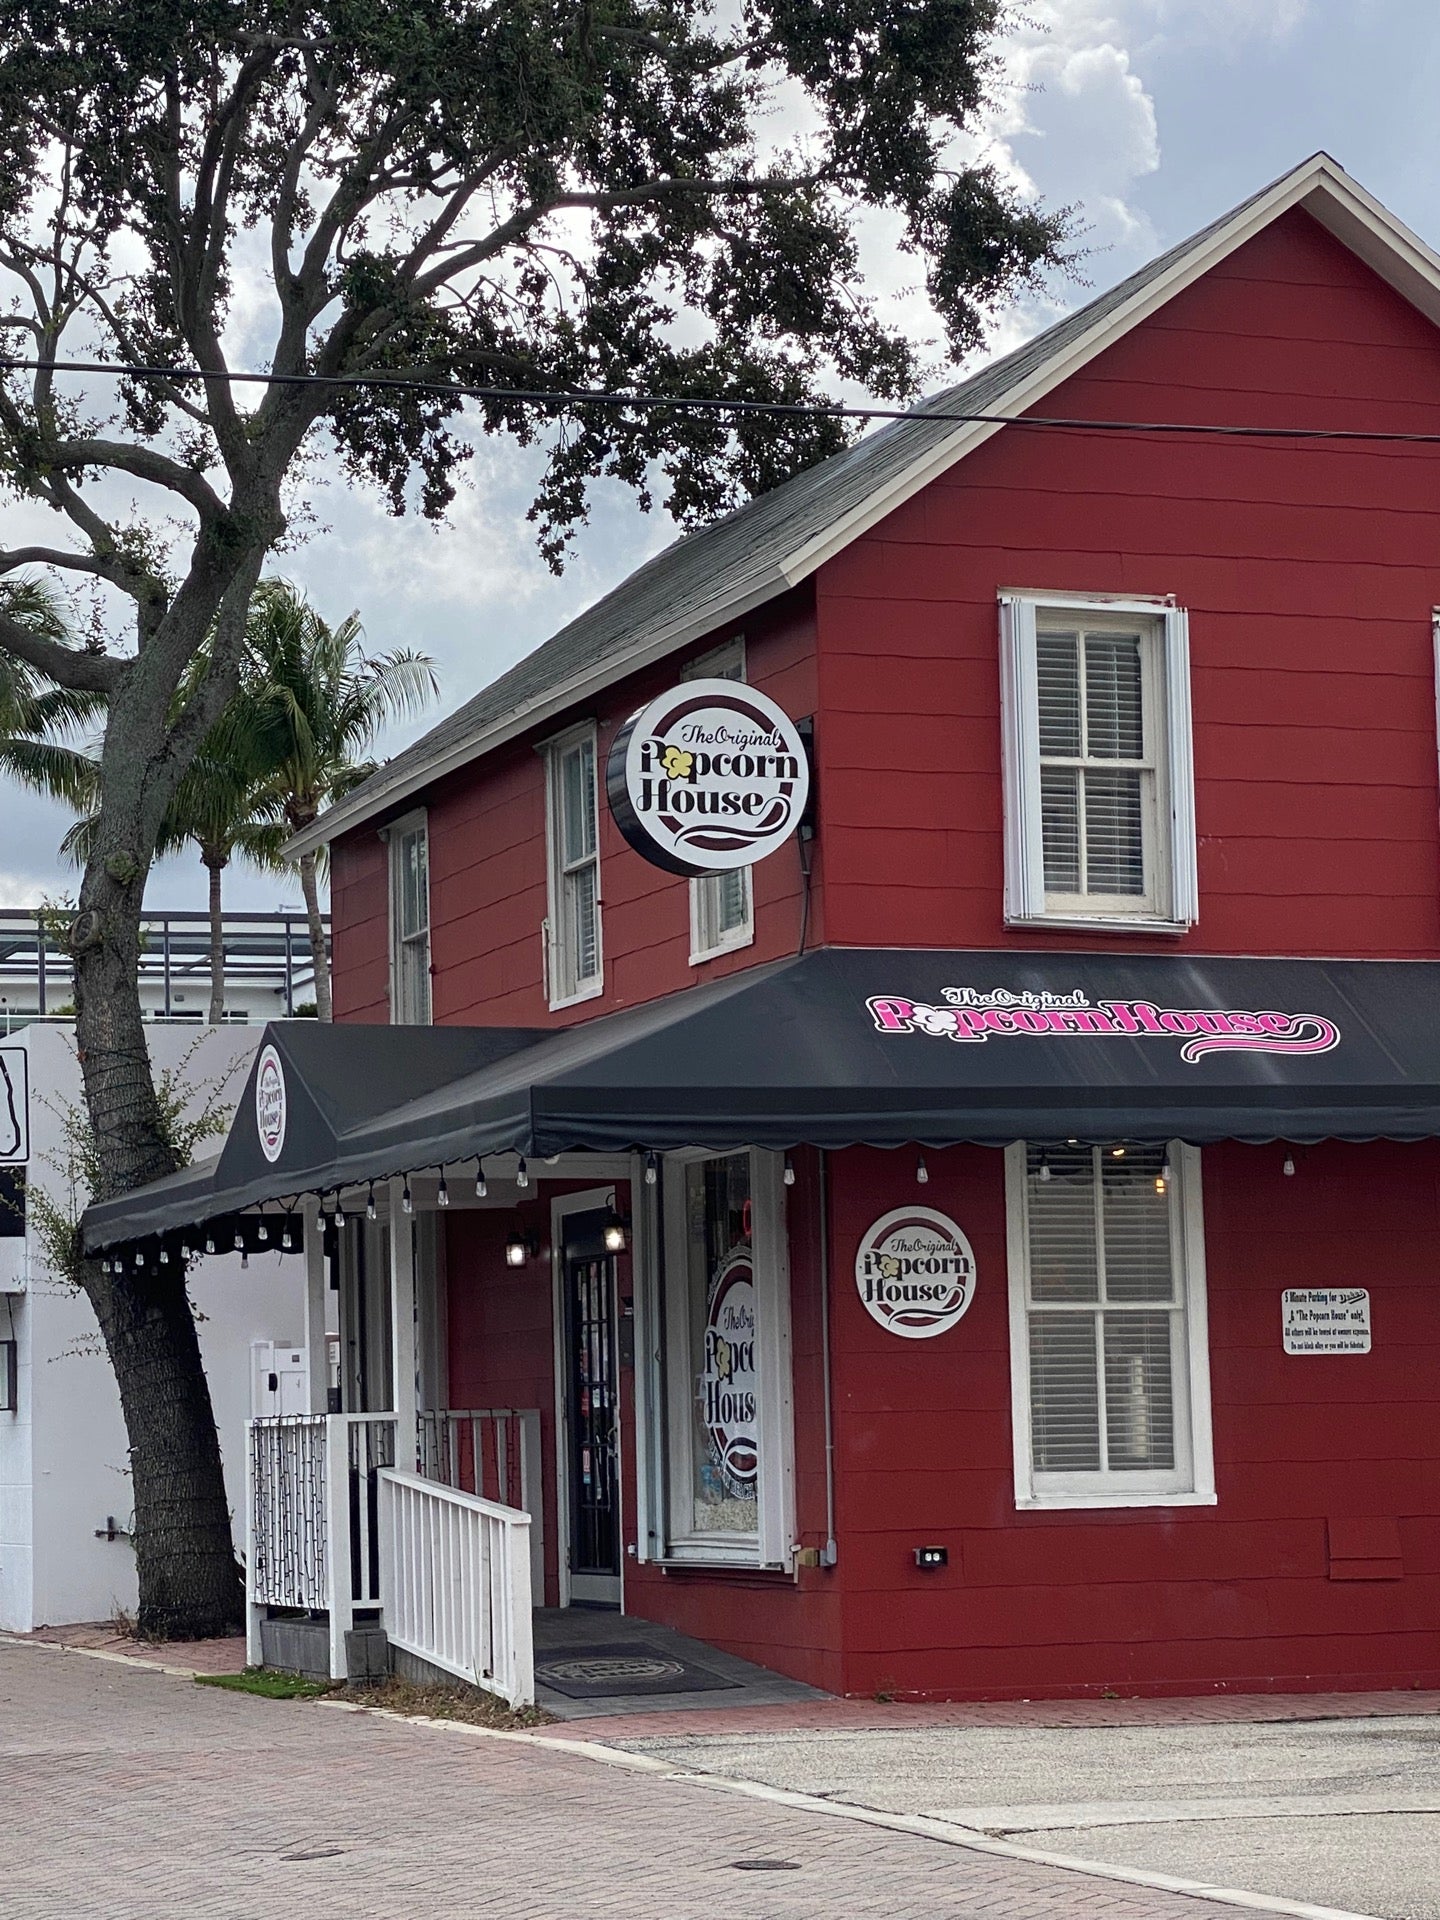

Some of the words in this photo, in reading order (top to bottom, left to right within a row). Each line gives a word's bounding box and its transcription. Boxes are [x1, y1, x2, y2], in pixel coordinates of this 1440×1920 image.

[681, 724, 714, 744] The
[714, 725, 781, 751] Original
[636, 778, 766, 816] House
[943, 987, 993, 1005] The
[993, 988, 1090, 1010] Original
[890, 1239, 912, 1252] The
[912, 1238, 956, 1256] Original
[862, 1278, 949, 1302] House
[1289, 1291, 1307, 1302] Minute
[1308, 1291, 1328, 1305] Parking
[1329, 1291, 1337, 1302] for
[1309, 1309, 1330, 1323] Popcorn
[1304, 1327, 1312, 1336] will
[704, 1380, 757, 1425] Hous
